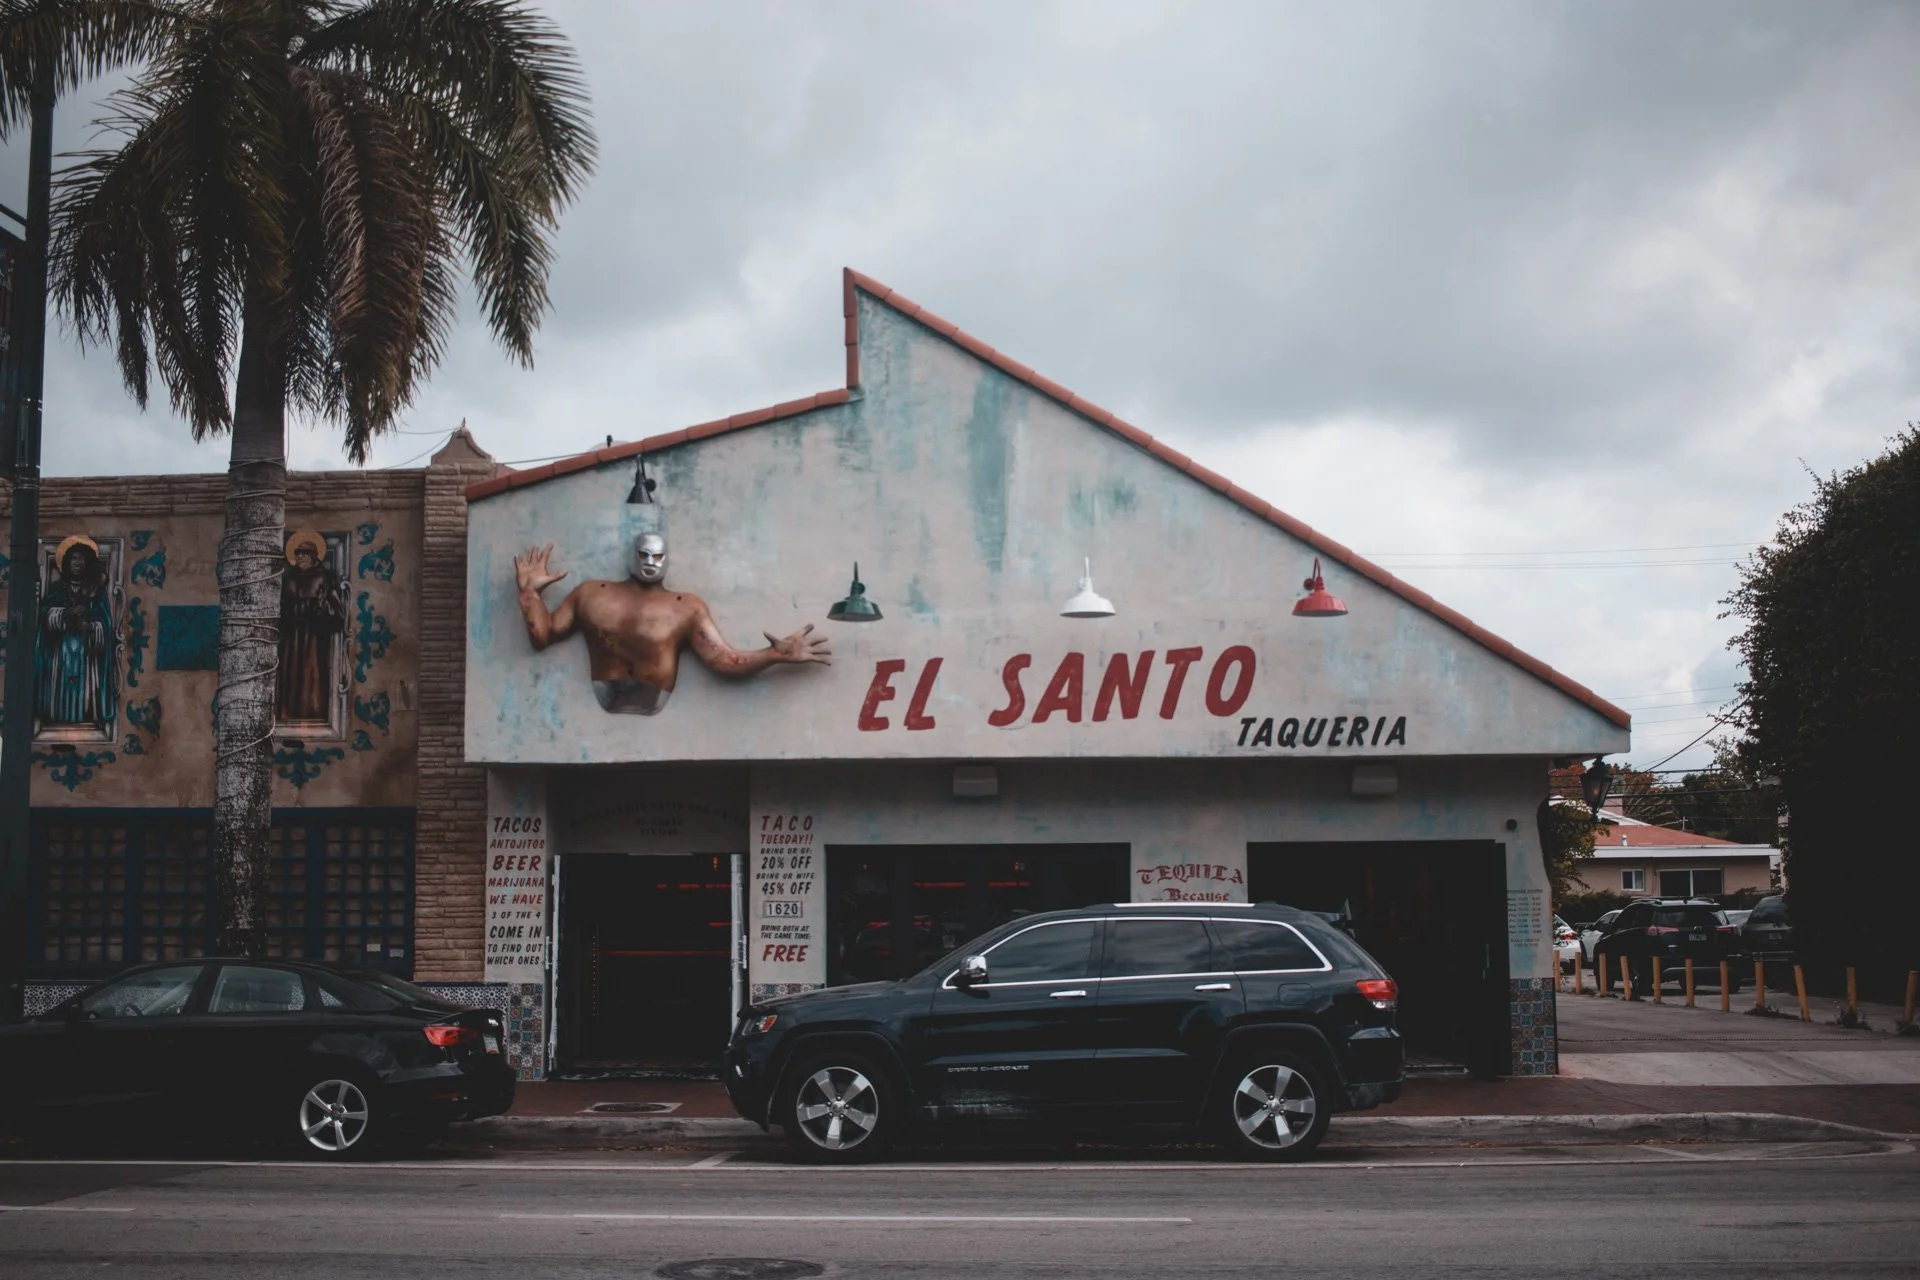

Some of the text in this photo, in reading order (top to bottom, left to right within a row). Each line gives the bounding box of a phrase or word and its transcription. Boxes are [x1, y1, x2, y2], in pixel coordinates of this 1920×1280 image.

[858, 645, 1256, 732] EL SANTO
[1237, 716, 1407, 748] TAQUERIA
[494, 816, 542, 833] TACOS
[762, 815, 813, 831] TACO
[490, 839, 545, 850] ANTOJITOS
[760, 834, 814, 845] TUESDAY!!
[492, 855, 542, 871] BEER
[761, 856, 812, 870] 20% OFF
[1136, 863, 1244, 884] TEQUILA
[488, 877, 544, 888] MARIJUANA
[761, 882, 812, 895] 45% OFF
[489, 894, 544, 905] WE HAVE
[491, 911, 541, 919] 3 OF THE 4
[768, 903, 798, 915] 1620
[489, 926, 542, 938] COME IN
[760, 932, 772, 940] THE
[774, 932, 792, 940] SAME
[487, 943, 543, 953] TO FIND OUT
[762, 944, 808, 962] FREE
[487, 956, 514, 965] WHICH
